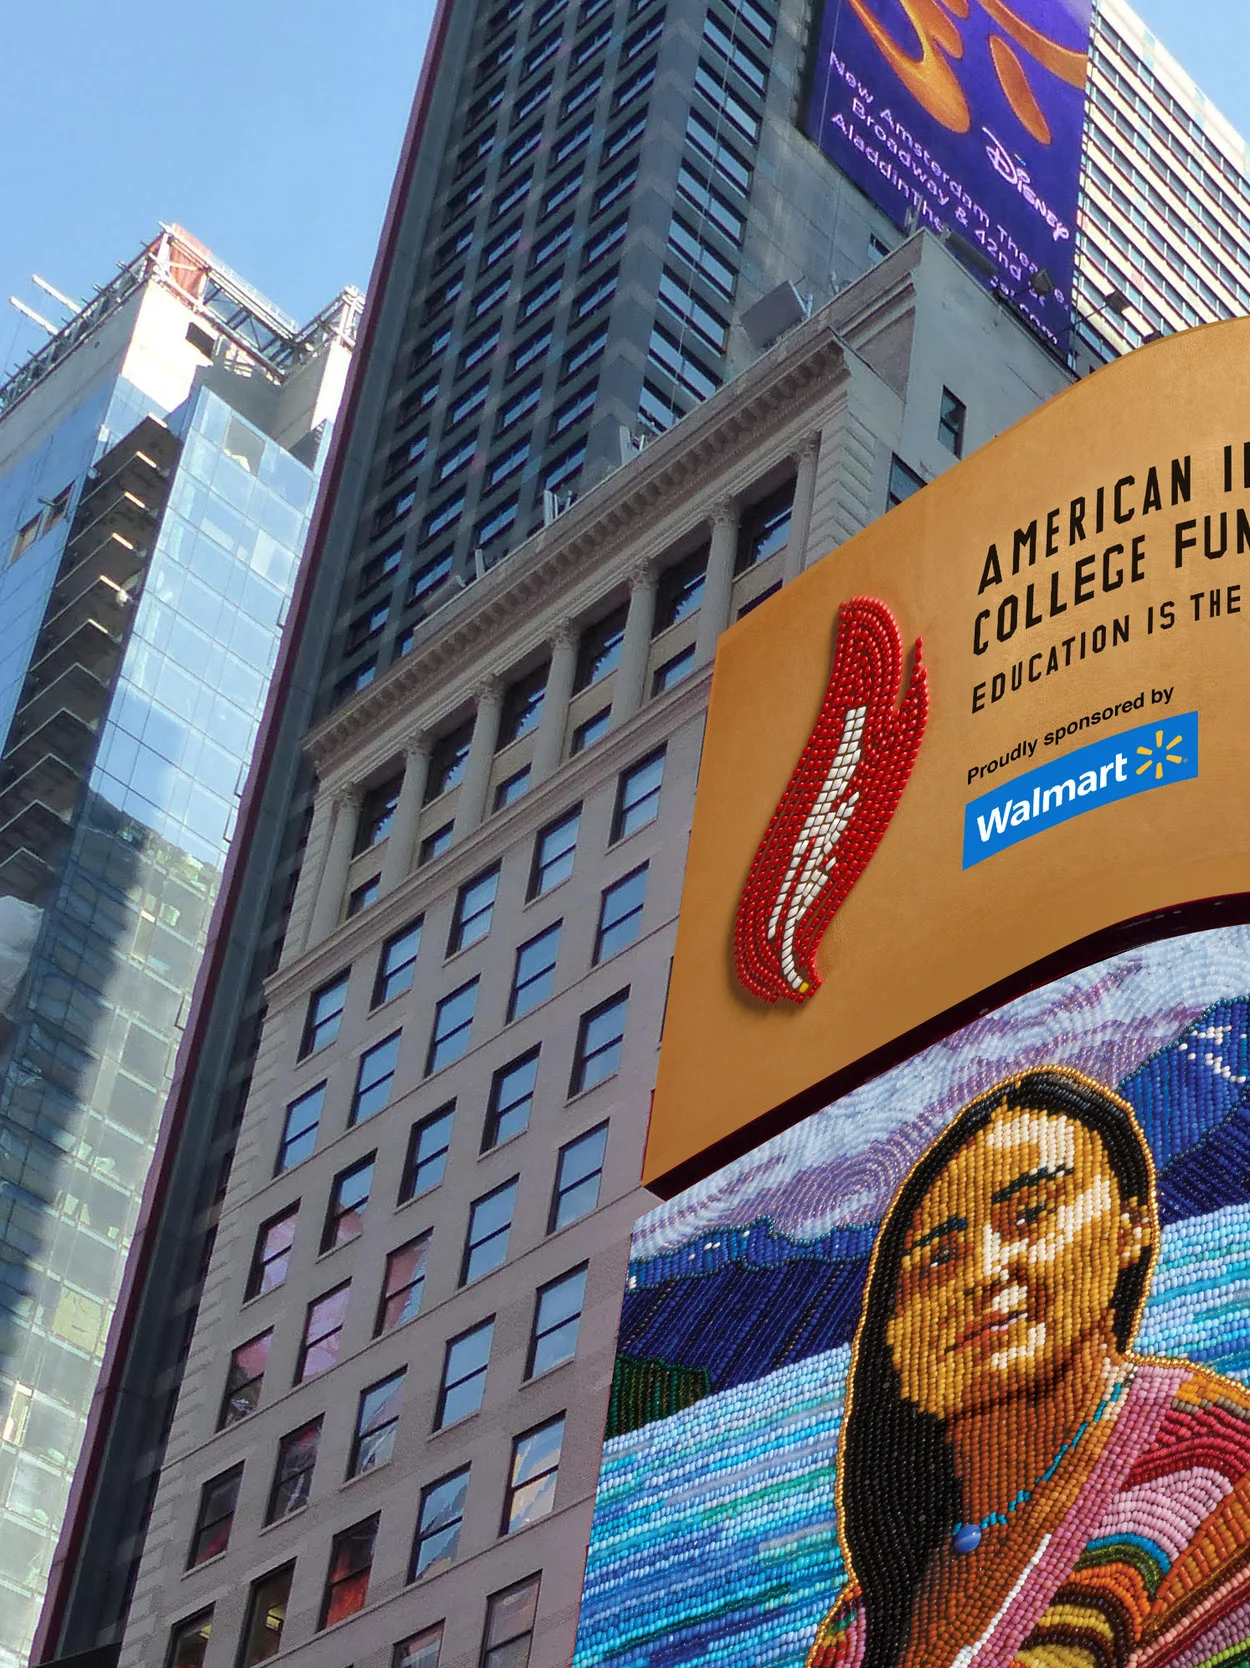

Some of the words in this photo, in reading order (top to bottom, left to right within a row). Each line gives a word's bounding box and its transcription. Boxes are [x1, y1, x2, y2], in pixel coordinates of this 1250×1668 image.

[830, 51, 874, 103] New
[881, 109, 990, 228] Amsterdam
[997, 225, 1069, 311] Theae,
[853, 98, 949, 206] Broadway
[955, 206, 968, 227] &
[974, 229, 1021, 281] 42nd
[978, 455, 1192, 596] AMERICAN
[971, 614, 1130, 715] EDUCATION
[1147, 601, 1175, 634] IS
[1190, 584, 1242, 621] THE
[973, 534, 1146, 656] COLLEGE
[967, 739, 1038, 785] Proudly
[1043, 693, 1145, 749] sponsored
[1150, 687, 1175, 713] by
[976, 752, 1128, 842] Walmart
